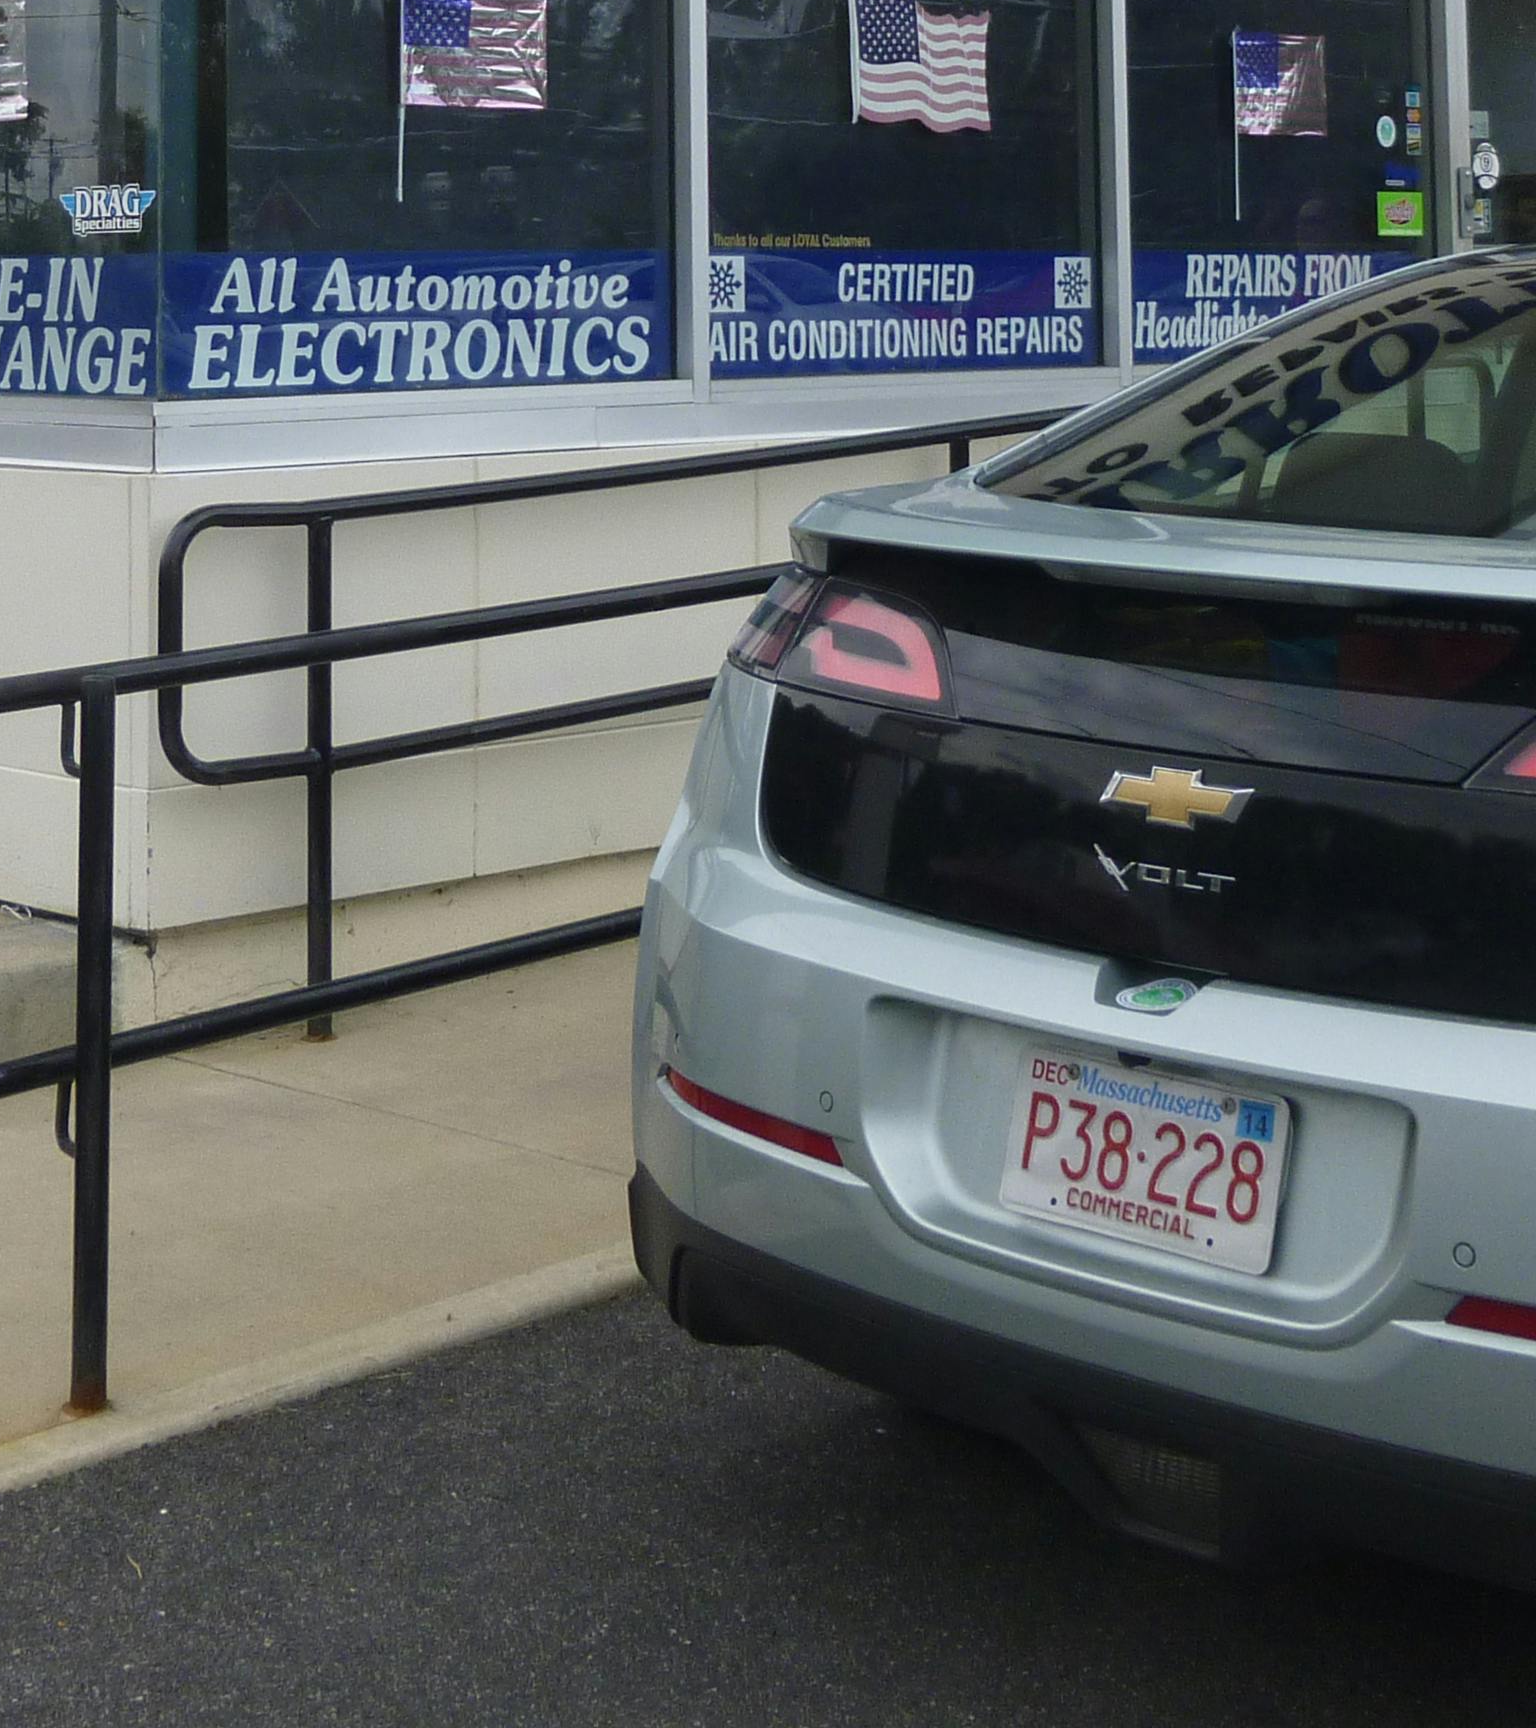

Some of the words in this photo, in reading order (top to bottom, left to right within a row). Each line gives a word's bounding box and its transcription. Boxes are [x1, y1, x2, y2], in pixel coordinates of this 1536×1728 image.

[74, 185, 141, 219] DRAG
[75, 216, 142, 233] Specialties
[209, 256, 298, 314] All
[313, 256, 630, 313] Automotive
[837, 261, 975, 304] CERTIFIED
[1185, 254, 1297, 299] REPAIRS
[1303, 253, 1372, 297] FROM
[188, 316, 651, 390] ELECTRONICS
[710, 320, 759, 363] AIR
[768, 318, 967, 361] CONDITIONING
[975, 315, 1084, 356] REPAIRS
[1093, 842, 1237, 894] VOLT
[1031, 1057, 1070, 1087] DEC
[1075, 1064, 1223, 1123] Massachusetts
[1243, 1111, 1269, 1138] 14
[1065, 1186, 1196, 1241] COMMERCIAL
